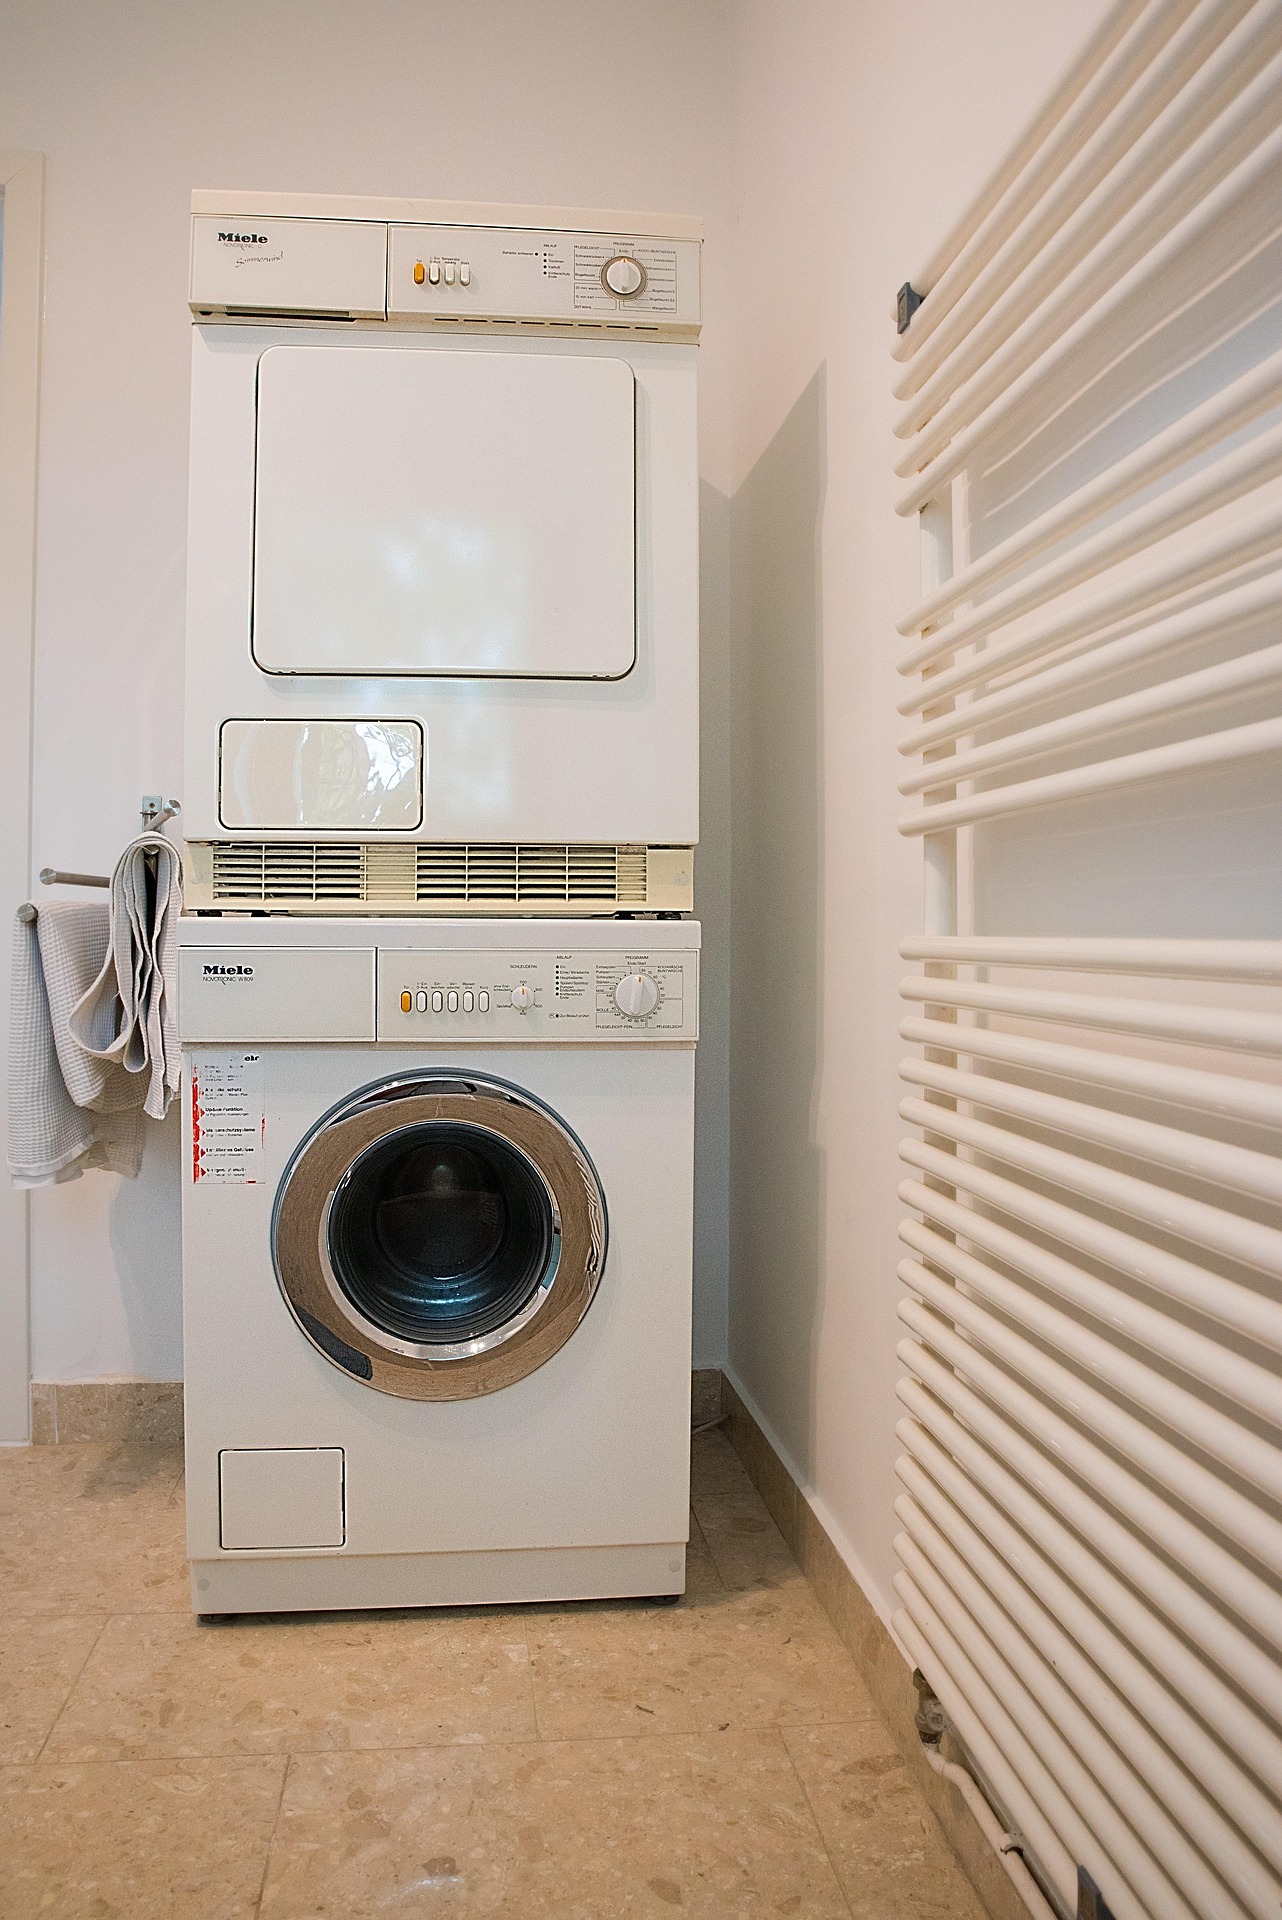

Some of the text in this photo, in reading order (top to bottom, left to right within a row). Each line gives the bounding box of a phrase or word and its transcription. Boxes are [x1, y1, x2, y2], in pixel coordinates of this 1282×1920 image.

[218, 232, 268, 243] Miele
[203, 966, 254, 974] Miele
[203, 976, 236, 985] NOVOTRONIC
